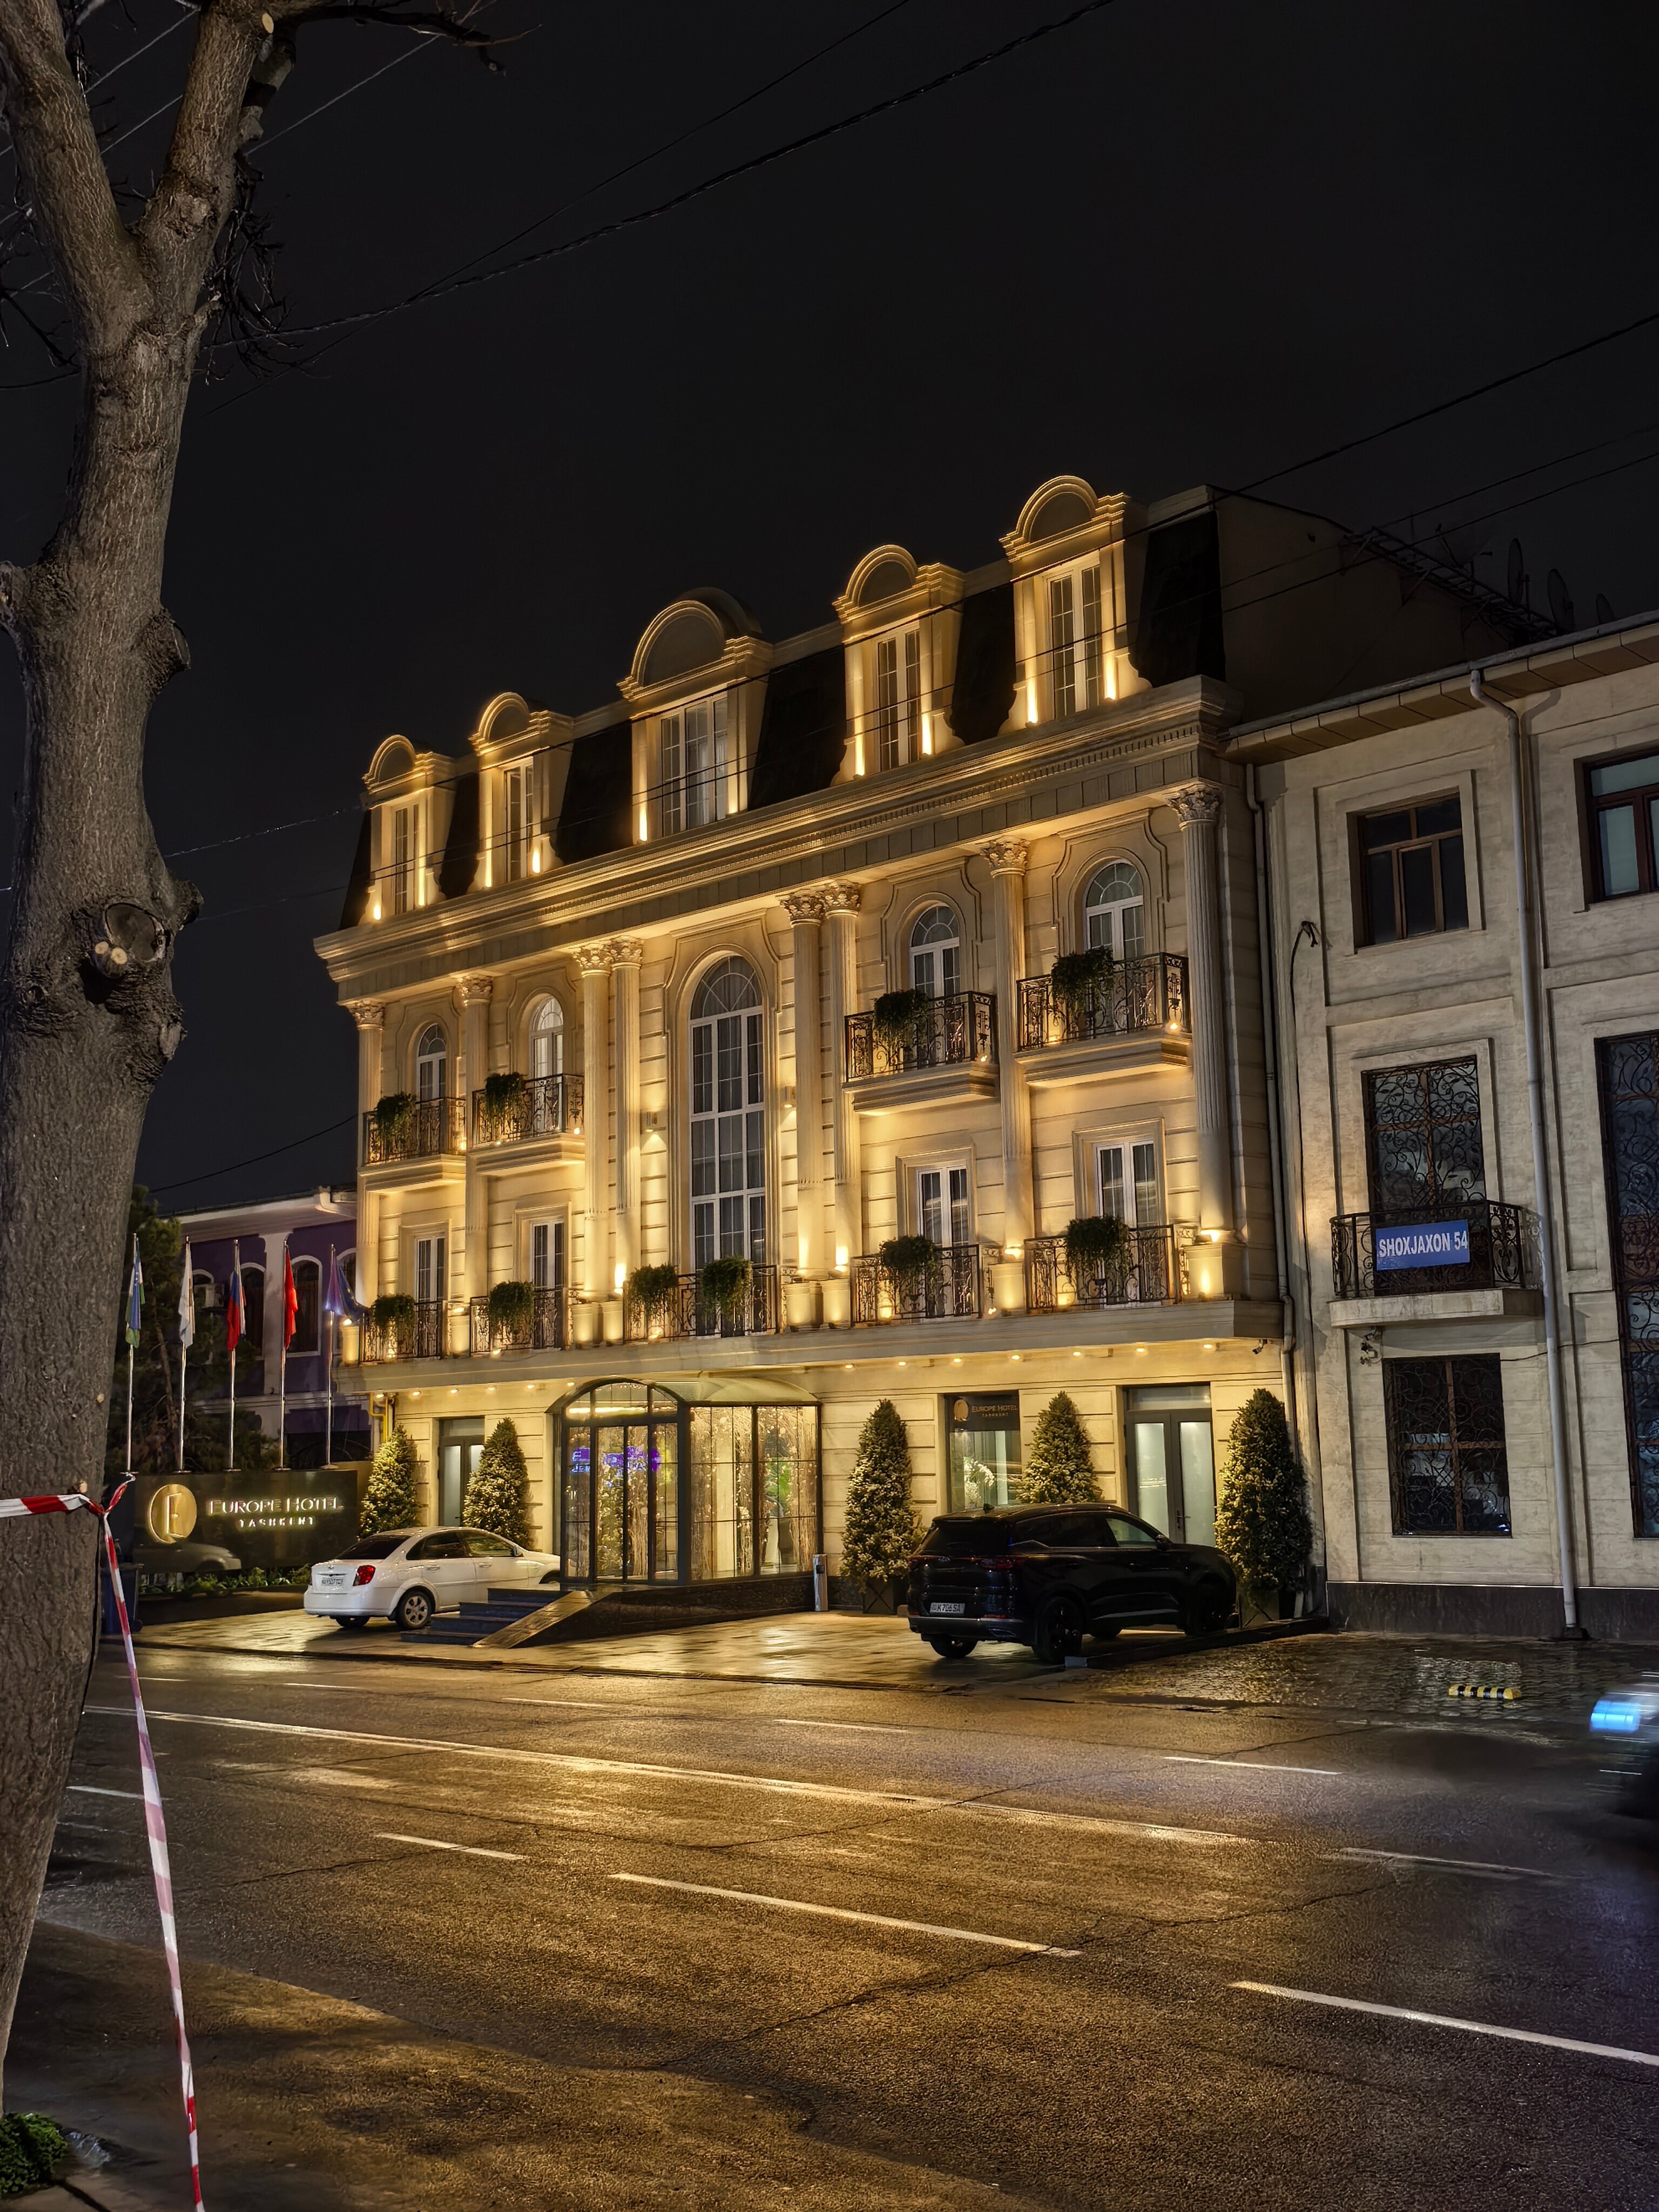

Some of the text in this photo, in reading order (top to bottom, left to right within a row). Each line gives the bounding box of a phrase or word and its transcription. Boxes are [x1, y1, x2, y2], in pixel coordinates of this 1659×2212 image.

[1379, 1230, 1468, 1258] SHOXJAXON 54
[210, 1496, 345, 1514] EUROPE HOTEL
[239, 1516, 314, 1528] TASHKENT
